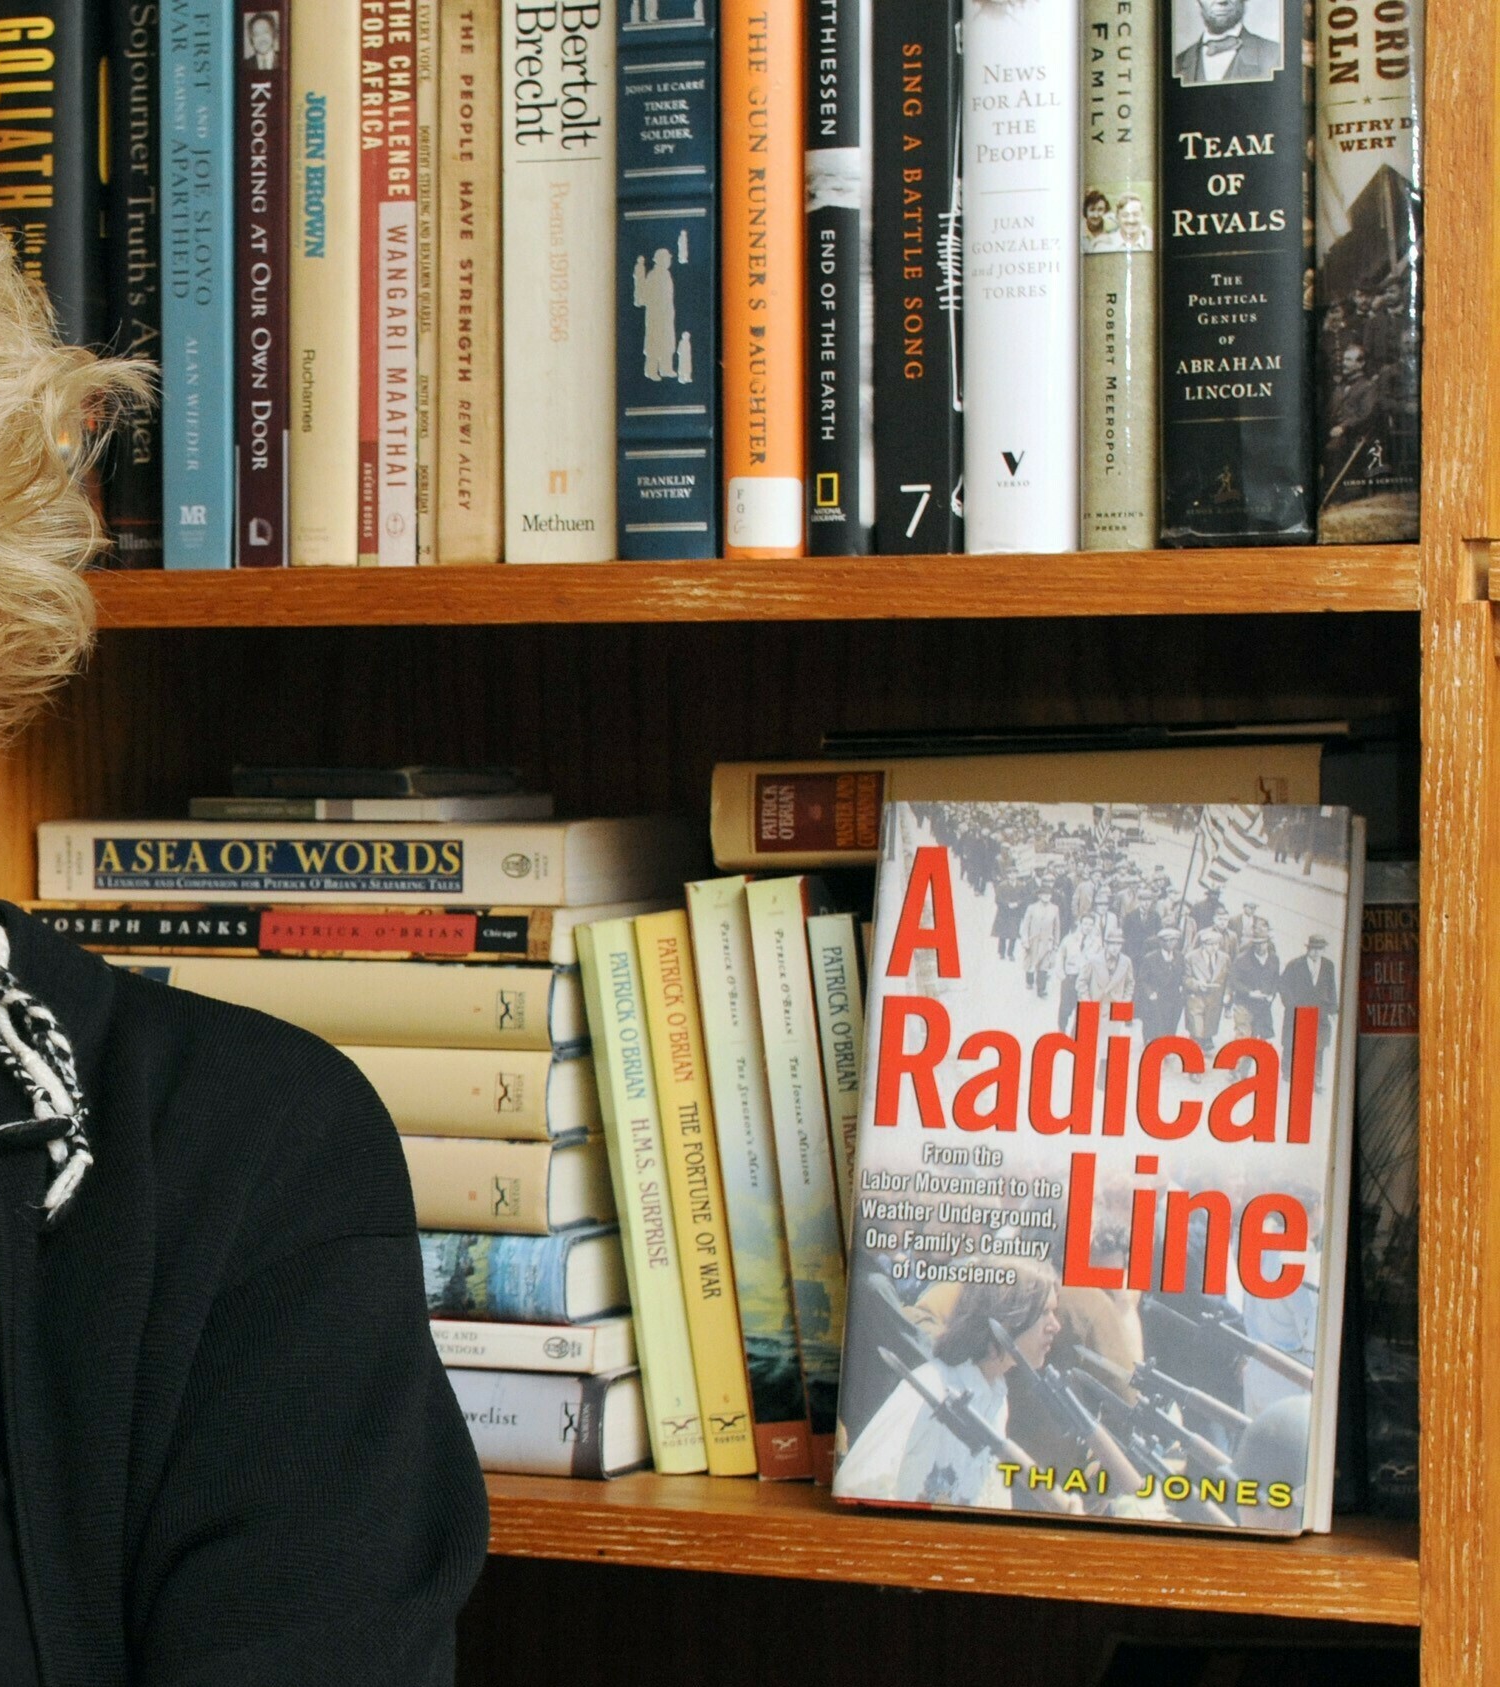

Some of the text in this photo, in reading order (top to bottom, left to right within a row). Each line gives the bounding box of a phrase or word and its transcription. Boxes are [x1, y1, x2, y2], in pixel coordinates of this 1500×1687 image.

[418, 4, 432, 82] EVERY VOICE
[361, 1, 386, 151] FOR AFRICA
[514, 2, 558, 146] Brecht
[560, 0, 602, 150] Bertolt
[625, 84, 653, 96] JOHN
[983, 64, 1047, 85] NEWS
[1091, 22, 1110, 144] FAMILY
[387, 0, 412, 197] THE CHALLENGE
[972, 95, 1011, 112] FOR
[992, 119, 1038, 136] THE
[1328, 118, 1394, 139] JEFFRY
[1338, 135, 1397, 153] WERT
[123, 4, 160, 306] Sojourner Truth's
[189, 13, 213, 306] FIRST AND JOE SLOVO
[653, 143, 677, 155] SPY
[976, 143, 1056, 164] PEOPLE
[1178, 132, 1275, 160] TEAM
[171, 63, 191, 299] AGAINST APARTHEID
[303, 91, 328, 258] JOHN BROWN
[1207, 172, 1245, 196] OF
[457, 10, 474, 382] THE PEOPLE HAVE STRENGTH
[549, 180, 571, 247] Poems
[903, 42, 924, 381] SING A BATTLE SONG
[418, 125, 432, 333] DOROTHY STERLING AND BENJAMIN QUARLES
[747, 11, 768, 466] THE GUN DAUGHTER
[992, 215, 1037, 234] JUAN
[1171, 209, 1286, 238] RIVALS
[249, 82, 274, 472] KNOCKING AT OUR OWN DOOR
[971, 263, 994, 278] and
[1210, 272, 1243, 288] THE
[982, 284, 1048, 300] TORRES
[1187, 292, 1268, 308] POLITICAL
[820, 229, 836, 441] END OF THE EARTH
[1196, 310, 1258, 325] GENIUS
[386, 224, 409, 488] WANGARI MAATHAI
[1217, 335, 1236, 346] OF
[1175, 354, 1283, 376] ABRAHAM
[301, 349, 317, 434] Ruchames
[1103, 292, 1119, 476] ROBERT MEEROPOL
[1184, 381, 1274, 402] LINCOLN
[185, 336, 201, 472] ALAN WIEDER
[419, 375, 430, 440] ZENITH BOOKS
[457, 399, 472, 510] REWI ALLEY
[419, 464, 430, 515] DOUBLEDAY
[636, 474, 696, 488] FRANKLIN
[639, 487, 693, 501] MYSTERY
[996, 479, 1032, 488] VERSO
[363, 506, 375, 538] BOOKS
[522, 513, 595, 534] Methuen
[1096, 510, 1145, 519] MARTIN'S
[760, 784, 778, 840] PATRICK
[777, 784, 796, 840] O'BRIAN
[97, 841, 124, 873] A
[131, 840, 209, 873] SEA
[219, 841, 277, 874] OF
[291, 841, 461, 876] WORDS
[159, 919, 248, 936] BANKS
[885, 844, 962, 980] A
[272, 924, 465, 940] PATRICK O'BRIAN
[482, 927, 518, 939] Chicago
[720, 920, 734, 971] PATRICK
[773, 928, 787, 980] PATRICK
[1373, 960, 1406, 986] BLUE
[821, 946, 859, 1093] PATRICK O'BRIAN
[873, 994, 1321, 1146] Radical
[609, 951, 670, 1269] PATRICK O'BRIAN H.M.S. SURPRISE
[656, 937, 722, 1300] PATRICK O'BRIAN THE FORTUNE OF WAR
[922, 1143, 1003, 1167] From the
[861, 1170, 1063, 1199] Labor Movement to the
[861, 1199, 1059, 1231] Weather Underground,
[1061, 1151, 1310, 1301] Line
[865, 1228, 1051, 1262] One Family's Century
[892, 1259, 1018, 1286] of Conscience
[452, 1332, 478, 1342] AND
[996, 1462, 1295, 1510] THAI JONES
